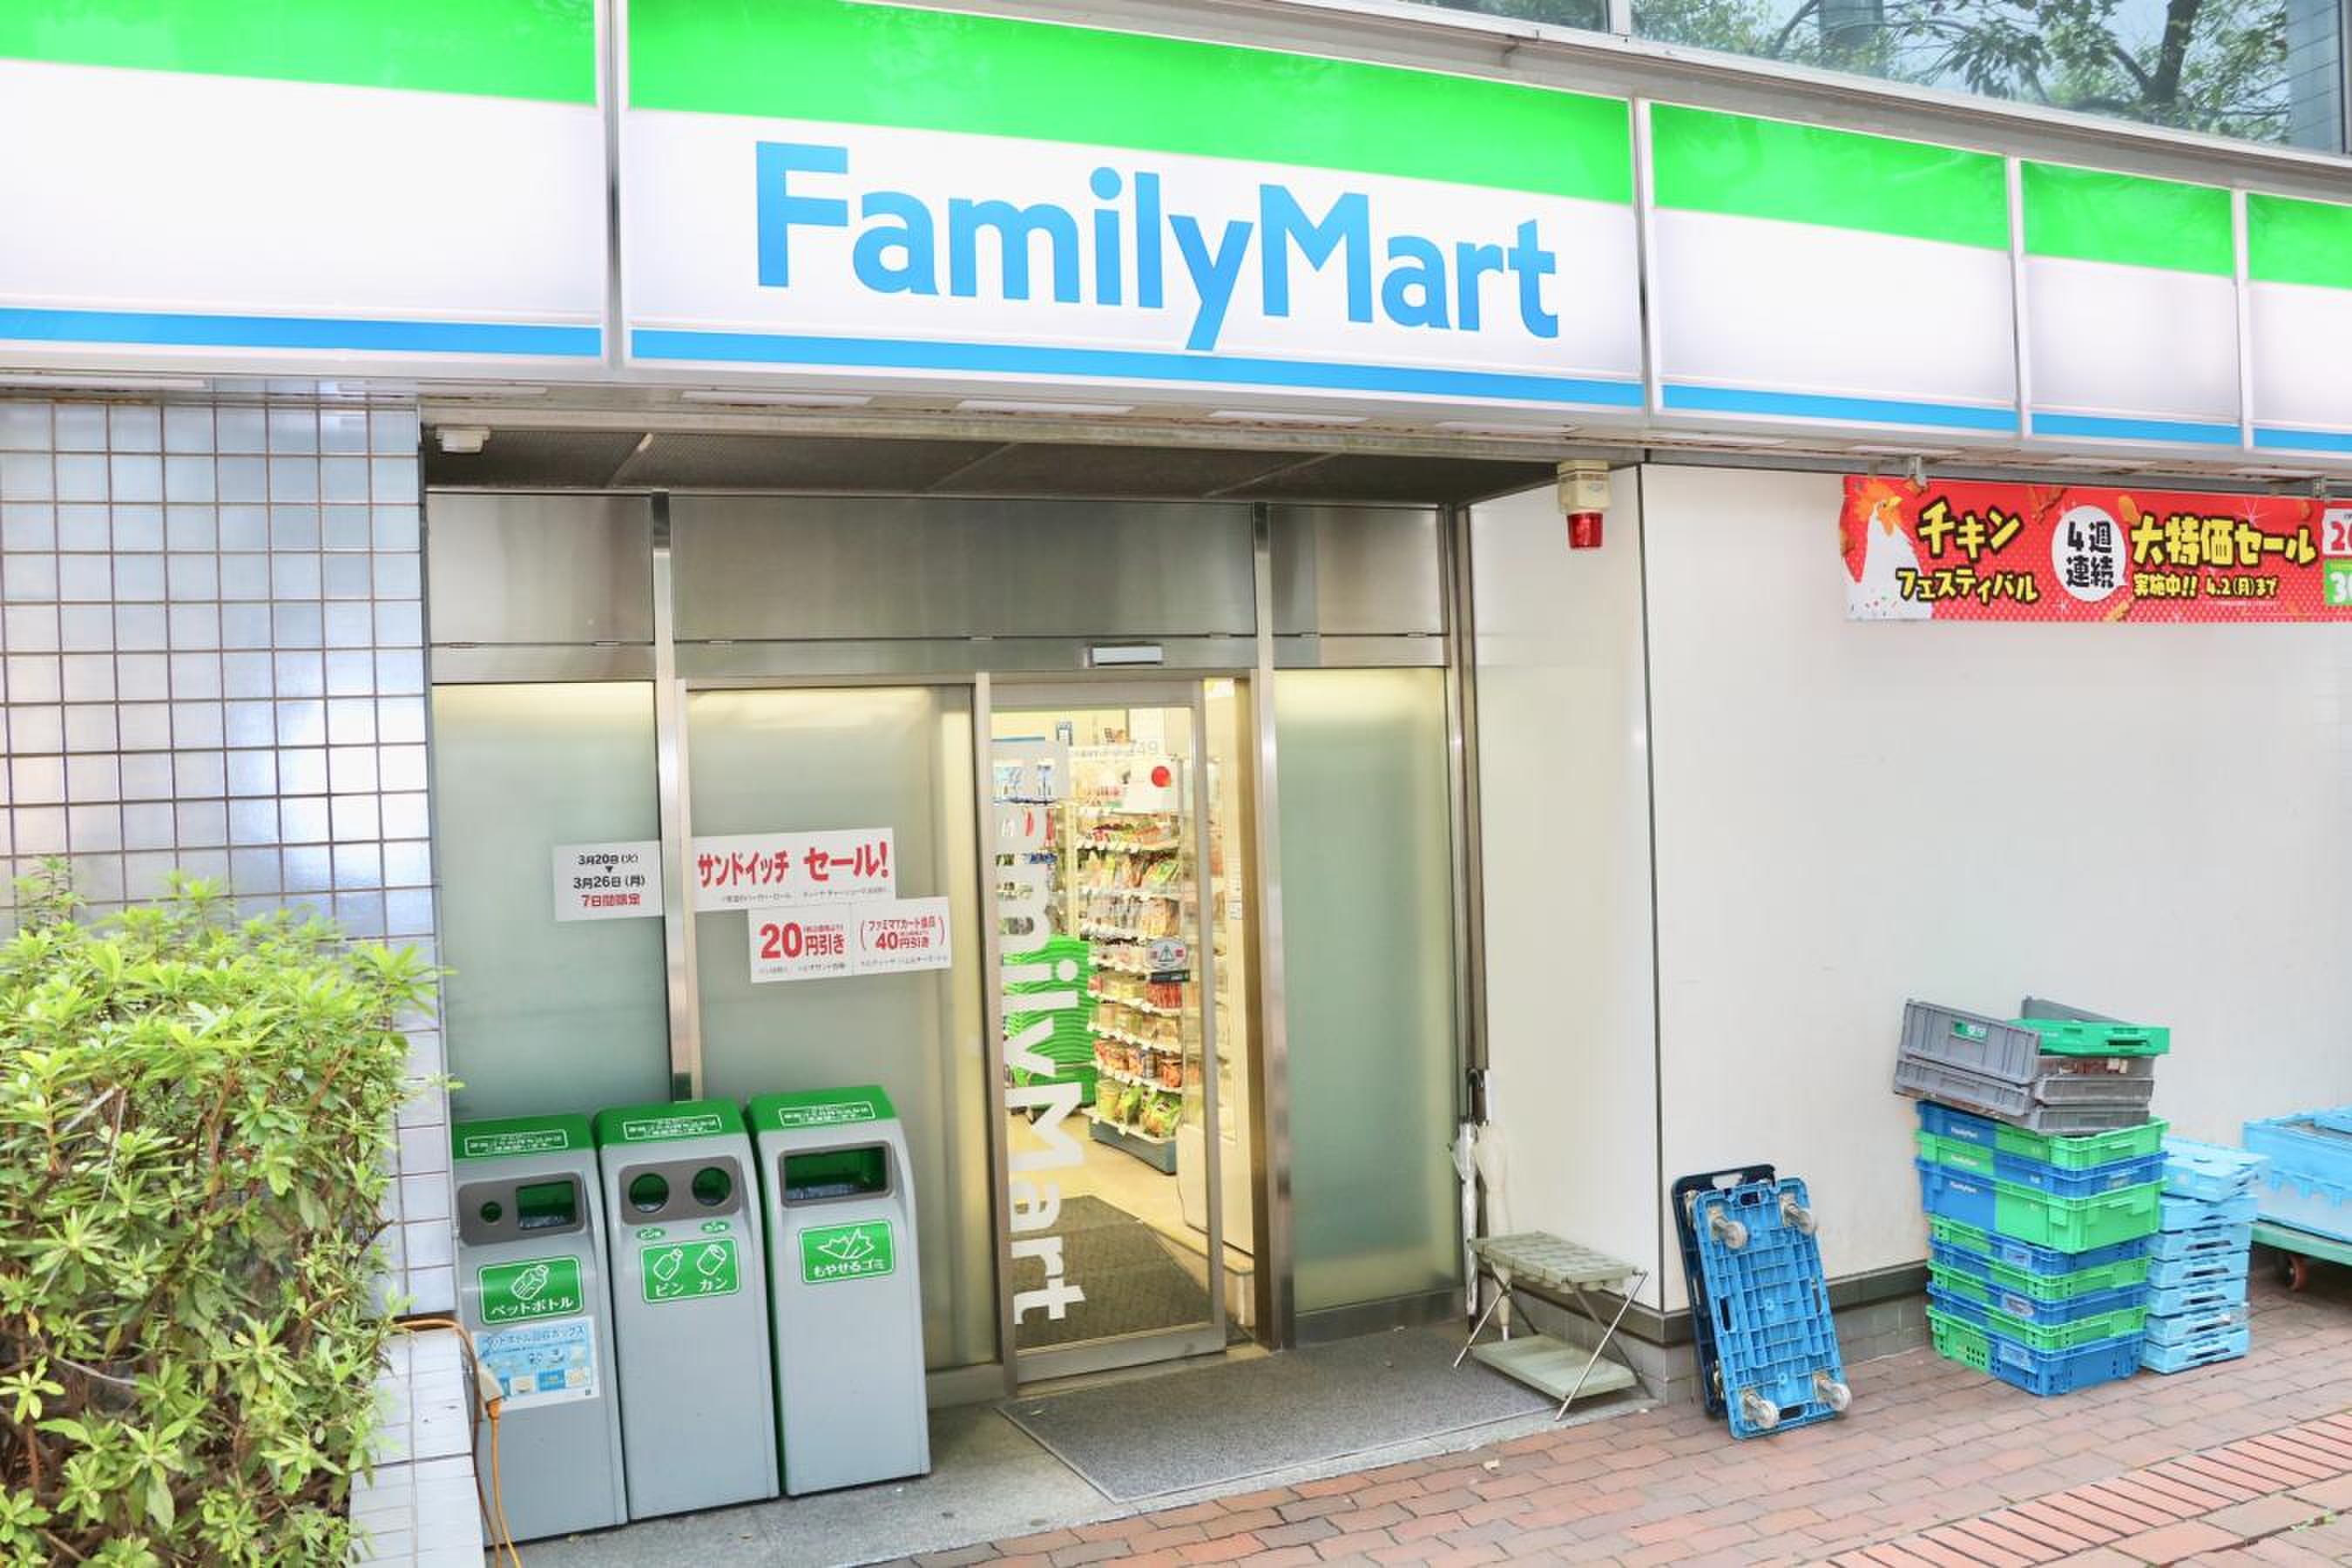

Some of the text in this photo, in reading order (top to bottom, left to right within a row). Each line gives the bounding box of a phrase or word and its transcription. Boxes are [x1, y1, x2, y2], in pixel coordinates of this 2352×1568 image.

[755, 140, 1559, 352] FamilyMart
[1916, 497, 2024, 563] チキン
[2068, 521, 2112, 552] 4週
[2130, 512, 2318, 566] 大特価セール
[1896, 565, 2041, 606] フェスティバル
[2066, 555, 2114, 589] 連続
[697, 841, 889, 889] サンドイッチ セール!
[814, 1258, 887, 1279] もやせるゴミ
[490, 1295, 575, 1317] ペットボトル
[655, 1278, 729, 1297] ビン カン
